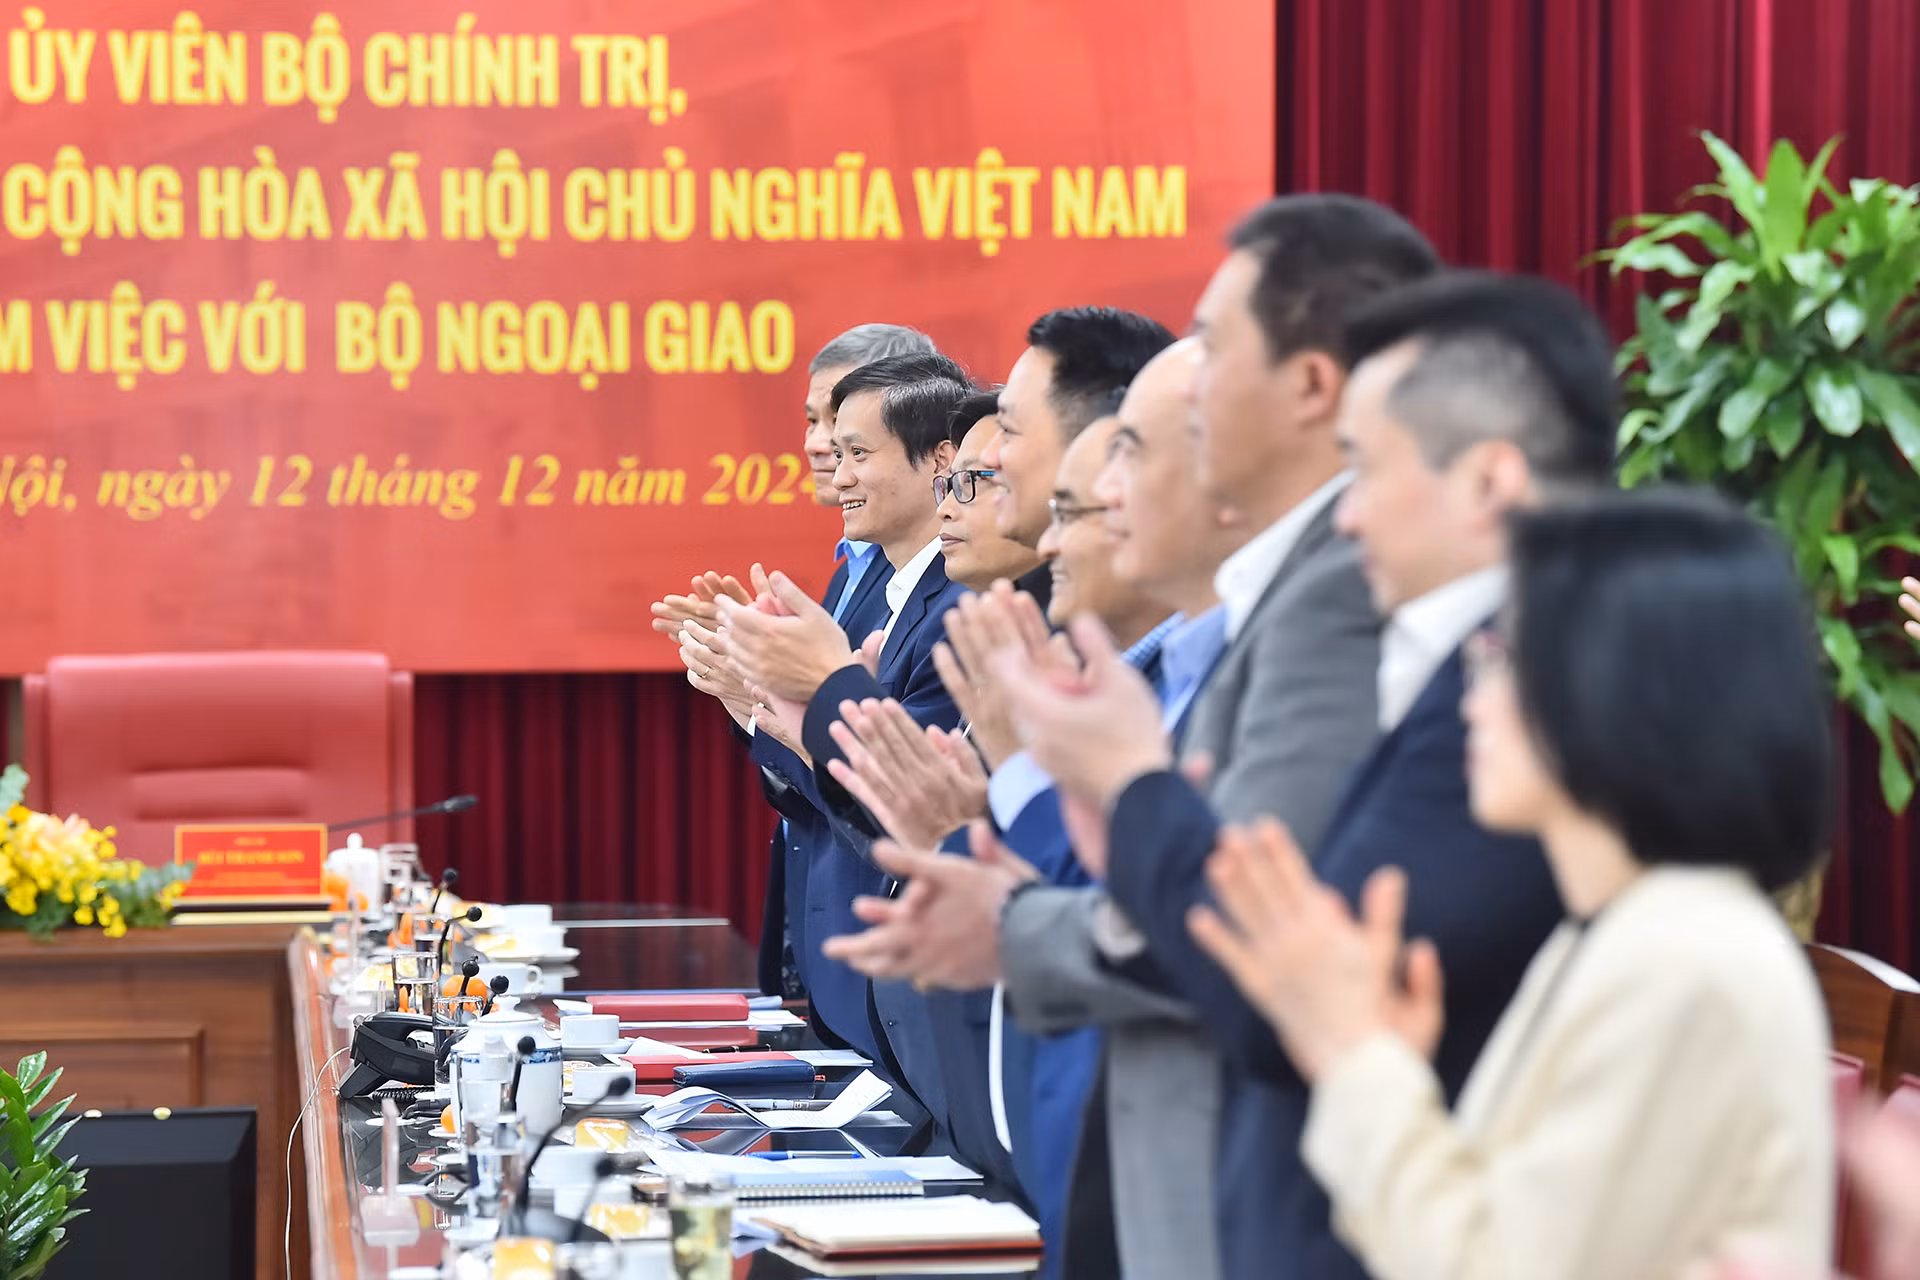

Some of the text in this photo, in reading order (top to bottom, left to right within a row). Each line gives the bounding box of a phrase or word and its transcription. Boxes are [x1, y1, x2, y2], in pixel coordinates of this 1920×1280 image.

[8, 6, 688, 126] ỦY VIÊN BỘ CHÍNH TRỊ,
[3, 145, 1187, 257] CỘNG HÒA XÃ HỘI CHỦ NGHĨA VIỆT NAM
[46, 280, 186, 390] VIỆC
[199, 280, 306, 374] VỚI
[336, 282, 422, 390] BỘ
[437, 300, 630, 390] NGOẠI
[644, 300, 795, 374] GIAO
[97, 454, 231, 519] ngày
[251, 455, 313, 506] 12
[327, 453, 481, 520] tháng
[499, 454, 561, 506] 12
[574, 455, 687, 506] năm
[703, 453, 817, 506] 202
